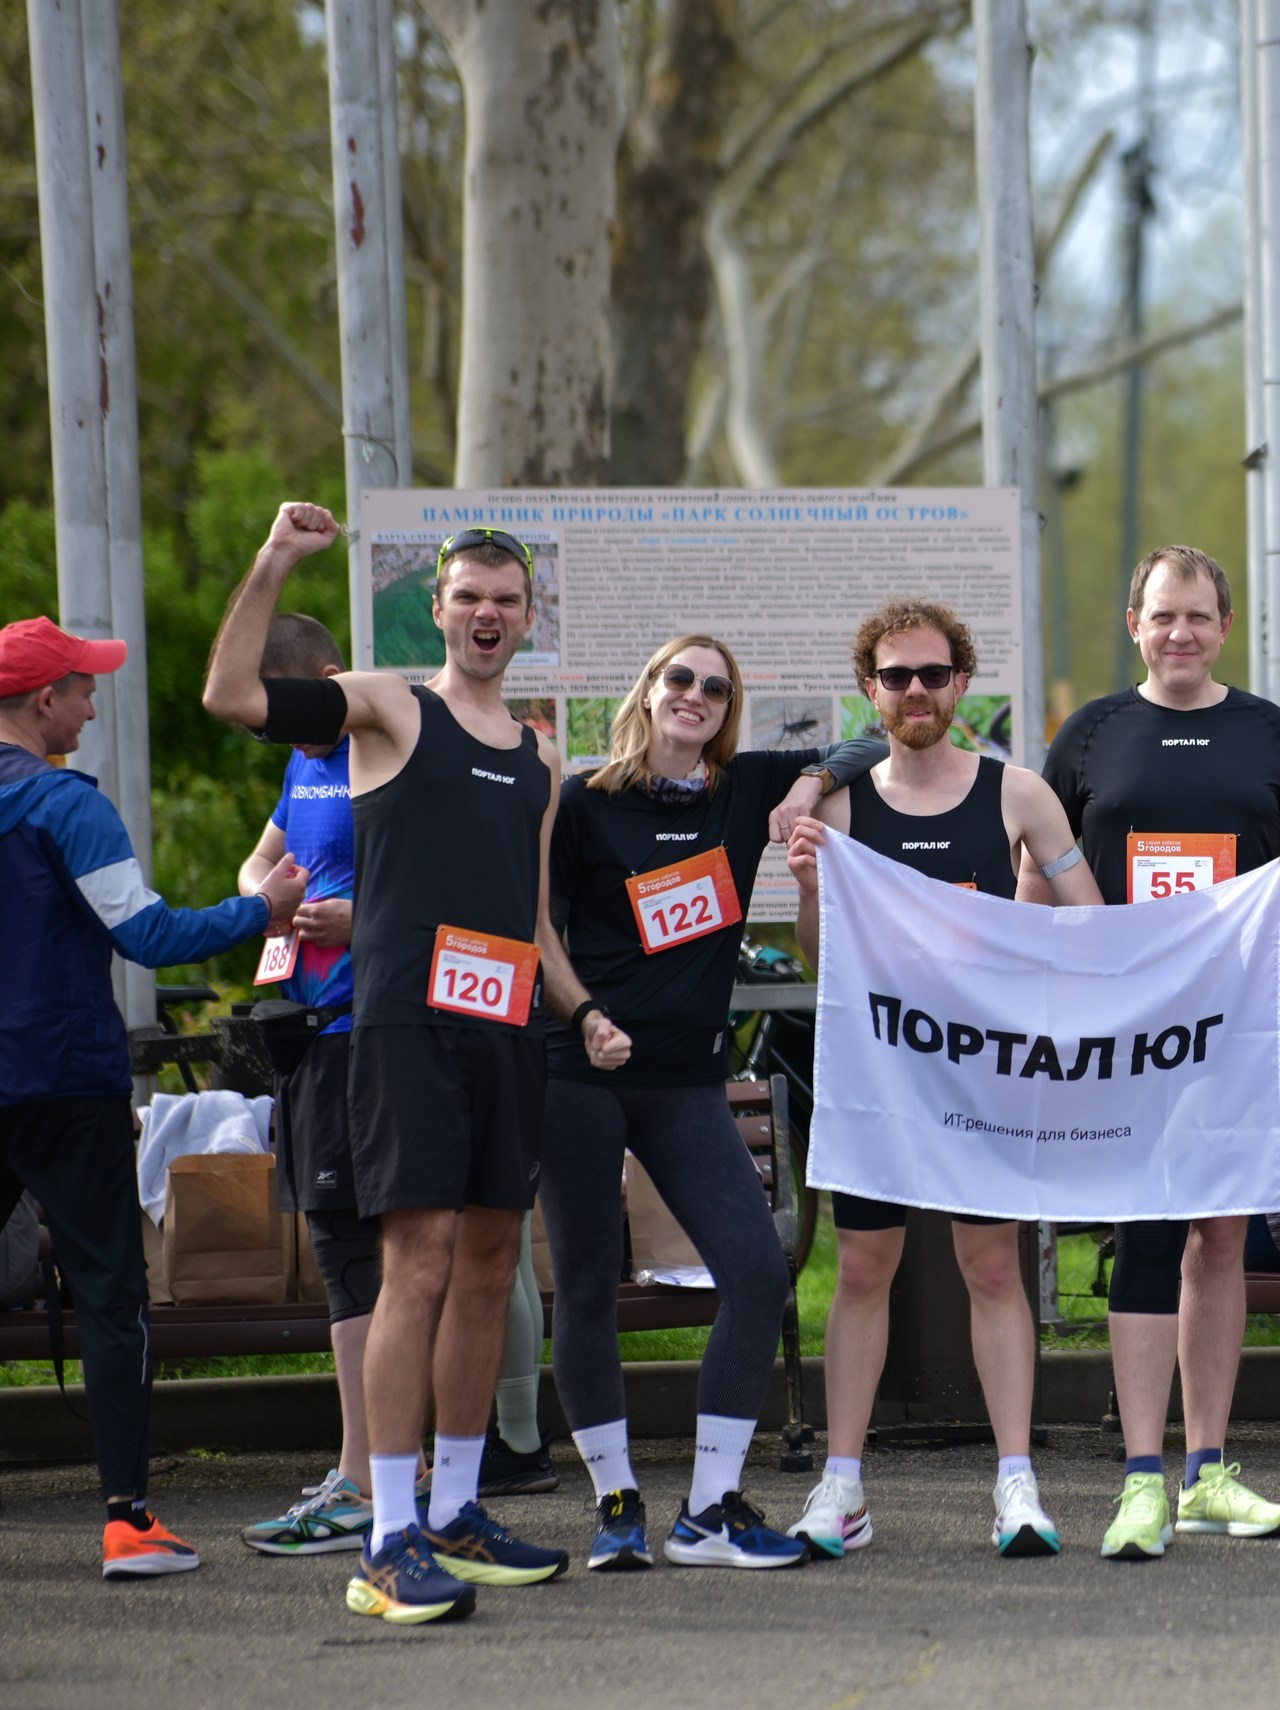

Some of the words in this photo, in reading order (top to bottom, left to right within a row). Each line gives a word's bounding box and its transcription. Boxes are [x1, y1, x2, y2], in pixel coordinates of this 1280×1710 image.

[422, 507, 544, 522] ПАМЯТНИК
[552, 507, 653, 523] ПРИРОДЫ
[662, 507, 727, 522] «ПАРК
[734, 505, 869, 522] СОЛНЕЧНЫЙ
[876, 506, 969, 522] ОСТРОВ»
[1197, 738, 1210, 746] ЮГ
[471, 767, 502, 781] ПОРТАЛ
[503, 776, 516, 784] ЮГ
[656, 833, 686, 841] ПОРТАЛ
[687, 832, 699, 840] ЮГ
[902, 842, 936, 850] ПОРТАЛ
[937, 841, 951, 849] ЮГ
[1137, 841, 1145, 852] 5
[1145, 845, 1181, 853] городов
[638, 882, 647, 894] 5
[646, 875, 682, 892] городов
[1150, 871, 1196, 900] 55
[651, 895, 713, 937] 122
[446, 934, 455, 947] 5
[453, 942, 487, 954] городов
[264, 943, 290, 973] 188
[443, 968, 503, 1007] 120
[868, 991, 1116, 1081] ПОРТАЛ
[1130, 1013, 1224, 1076] ЮГ
[943, 1111, 1034, 1140] ИТ-решения
[1037, 1127, 1067, 1142] для
[1070, 1125, 1132, 1142] бизнеса
